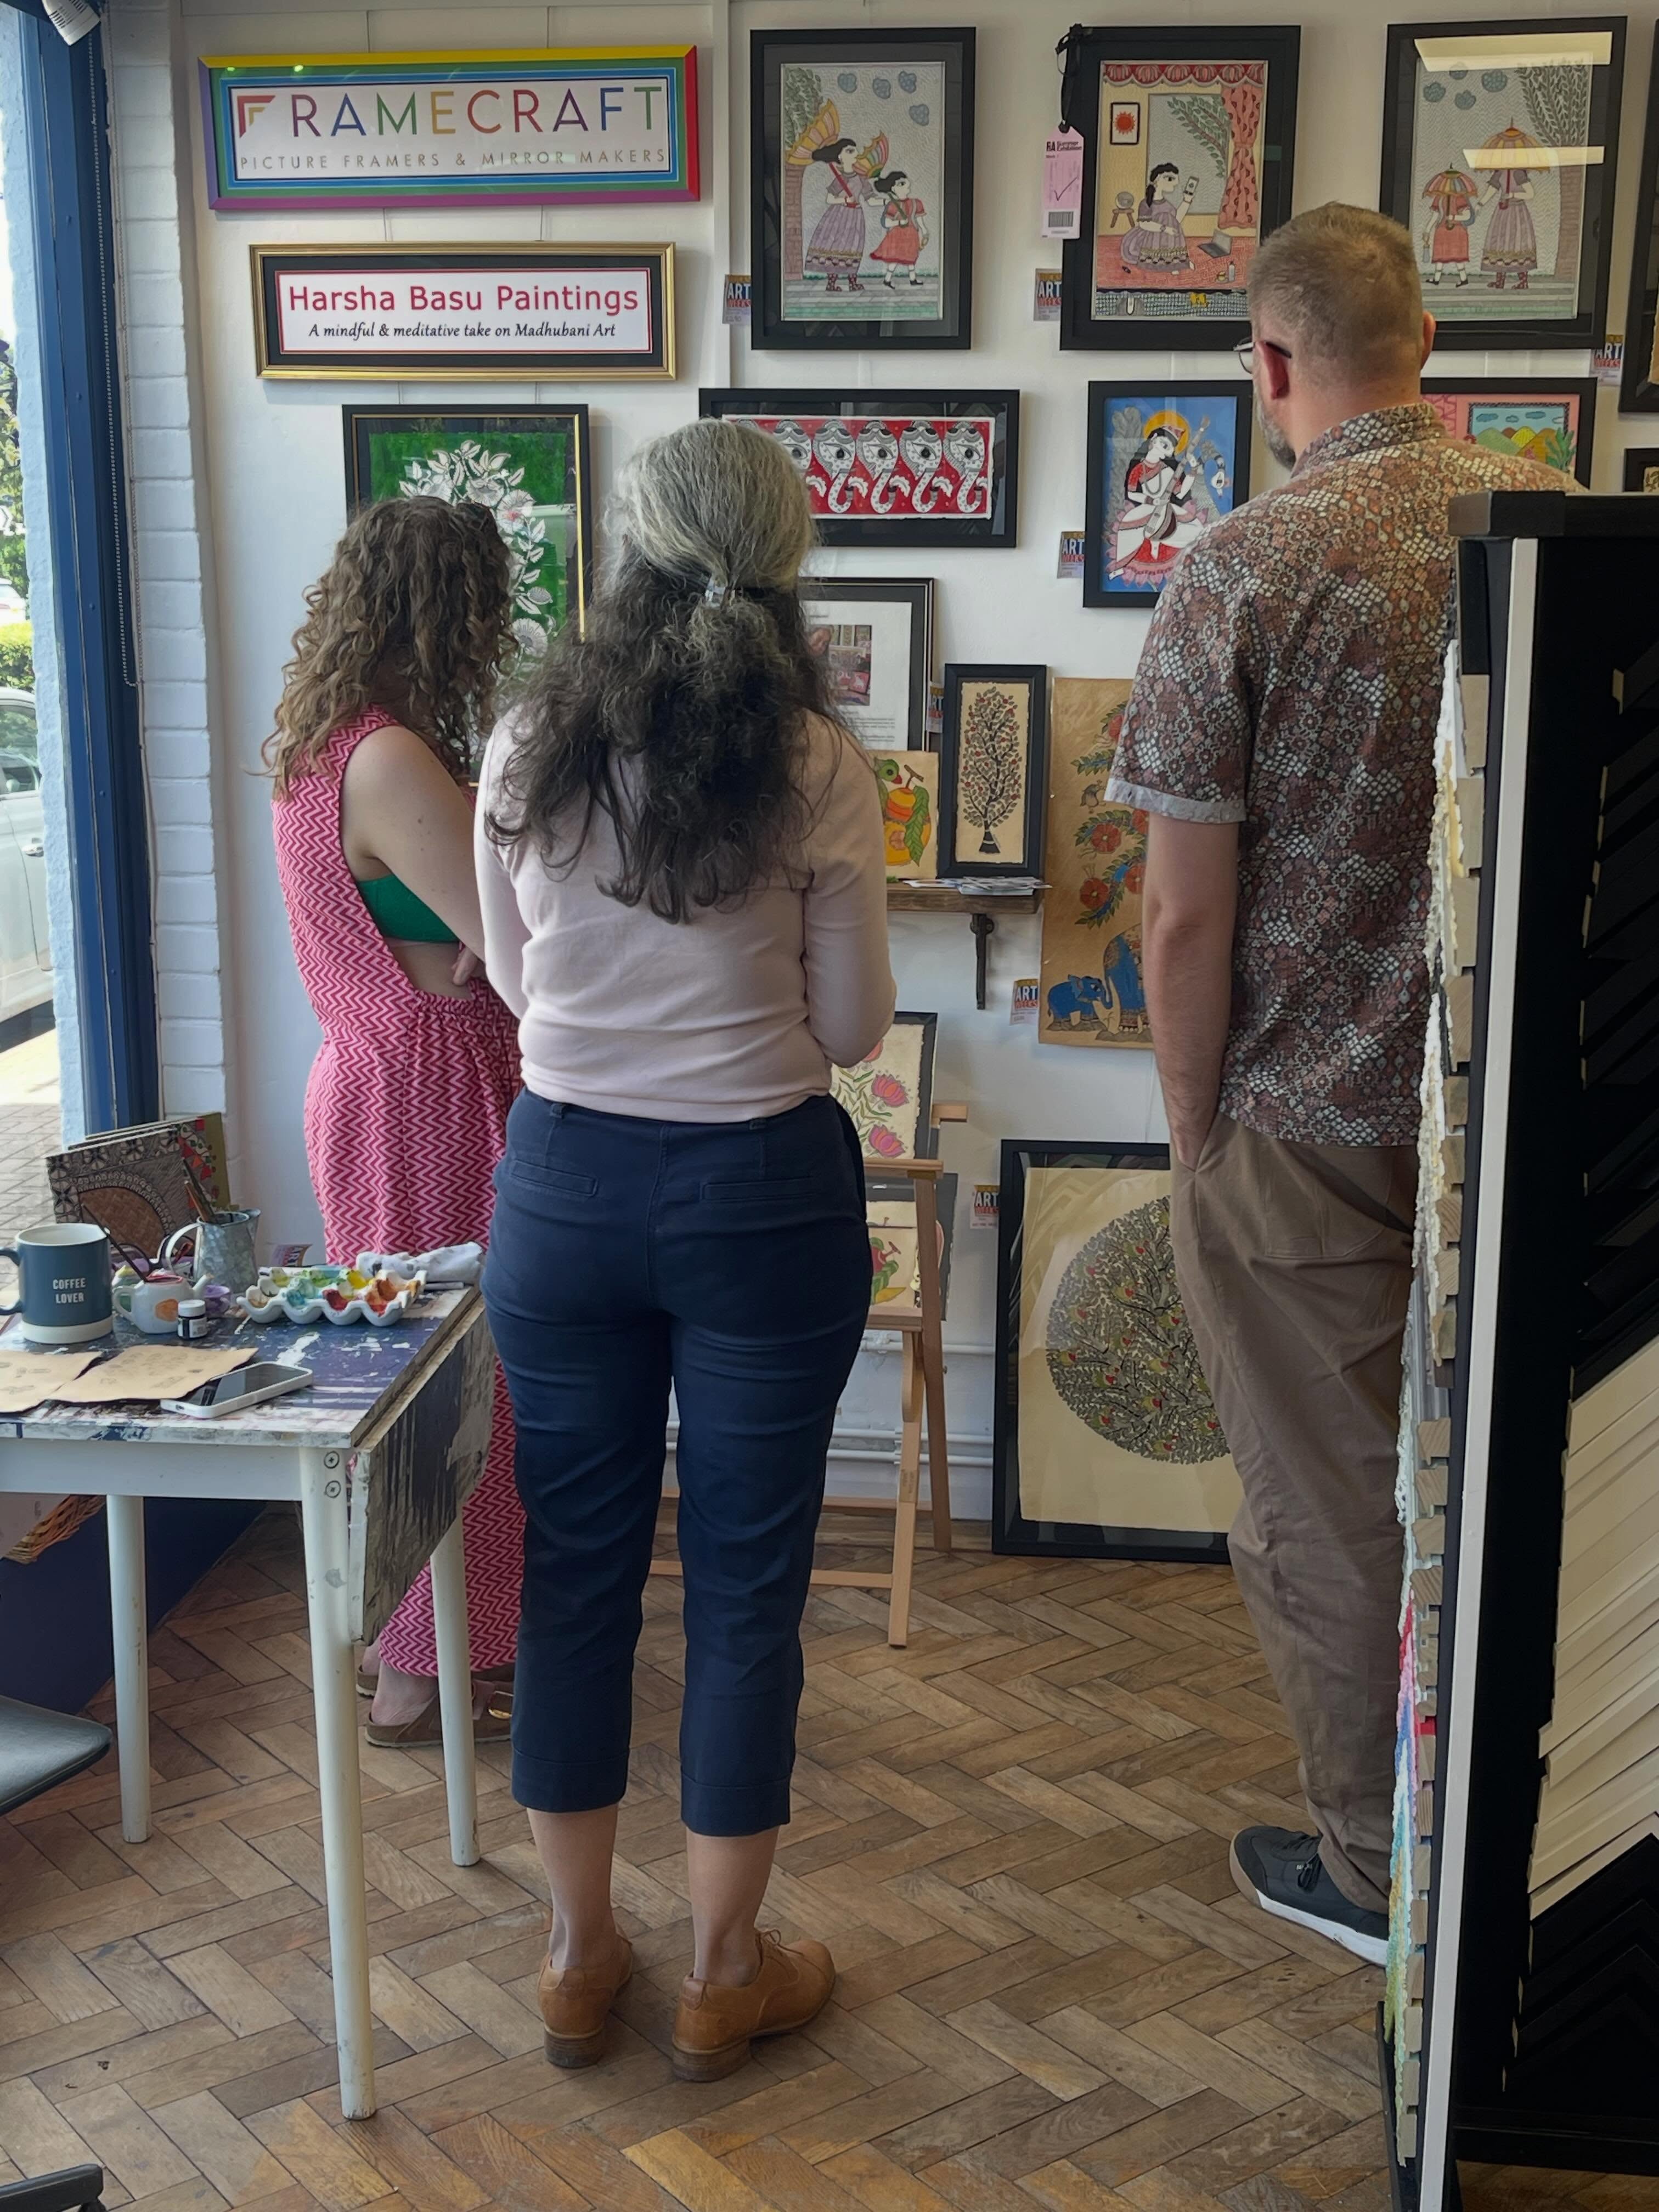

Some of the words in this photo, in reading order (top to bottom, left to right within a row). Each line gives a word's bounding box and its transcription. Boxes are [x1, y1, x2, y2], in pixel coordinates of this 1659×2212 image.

[240, 155, 328, 170] PICTURE
[343, 154, 439, 168] FRAMERS
[456, 153, 465, 166] &
[482, 151, 564, 165] MIRROR
[580, 149, 665, 163] MAKERS
[727, 283, 751, 299] ART
[1039, 280, 1062, 298] ART
[290, 285, 395, 311] Harsha
[410, 286, 482, 311] Basu
[497, 285, 638, 316] Paintings
[309, 324, 319, 336] A
[323, 321, 375, 341] mindful
[379, 324, 389, 336] &
[393, 321, 460, 336] meditative
[464, 322, 491, 336] take
[495, 327, 510, 336] on
[515, 321, 590, 336] Madhubani
[593, 324, 616, 336] Art
[1595, 343, 1622, 359] ART
[1062, 539, 1085, 555] ART
[1015, 986, 1037, 1001] ART
[975, 1192, 999, 1206] ART
[53, 1277, 87, 1289] COFFEE
[55, 1292, 84, 1304] LOVER
